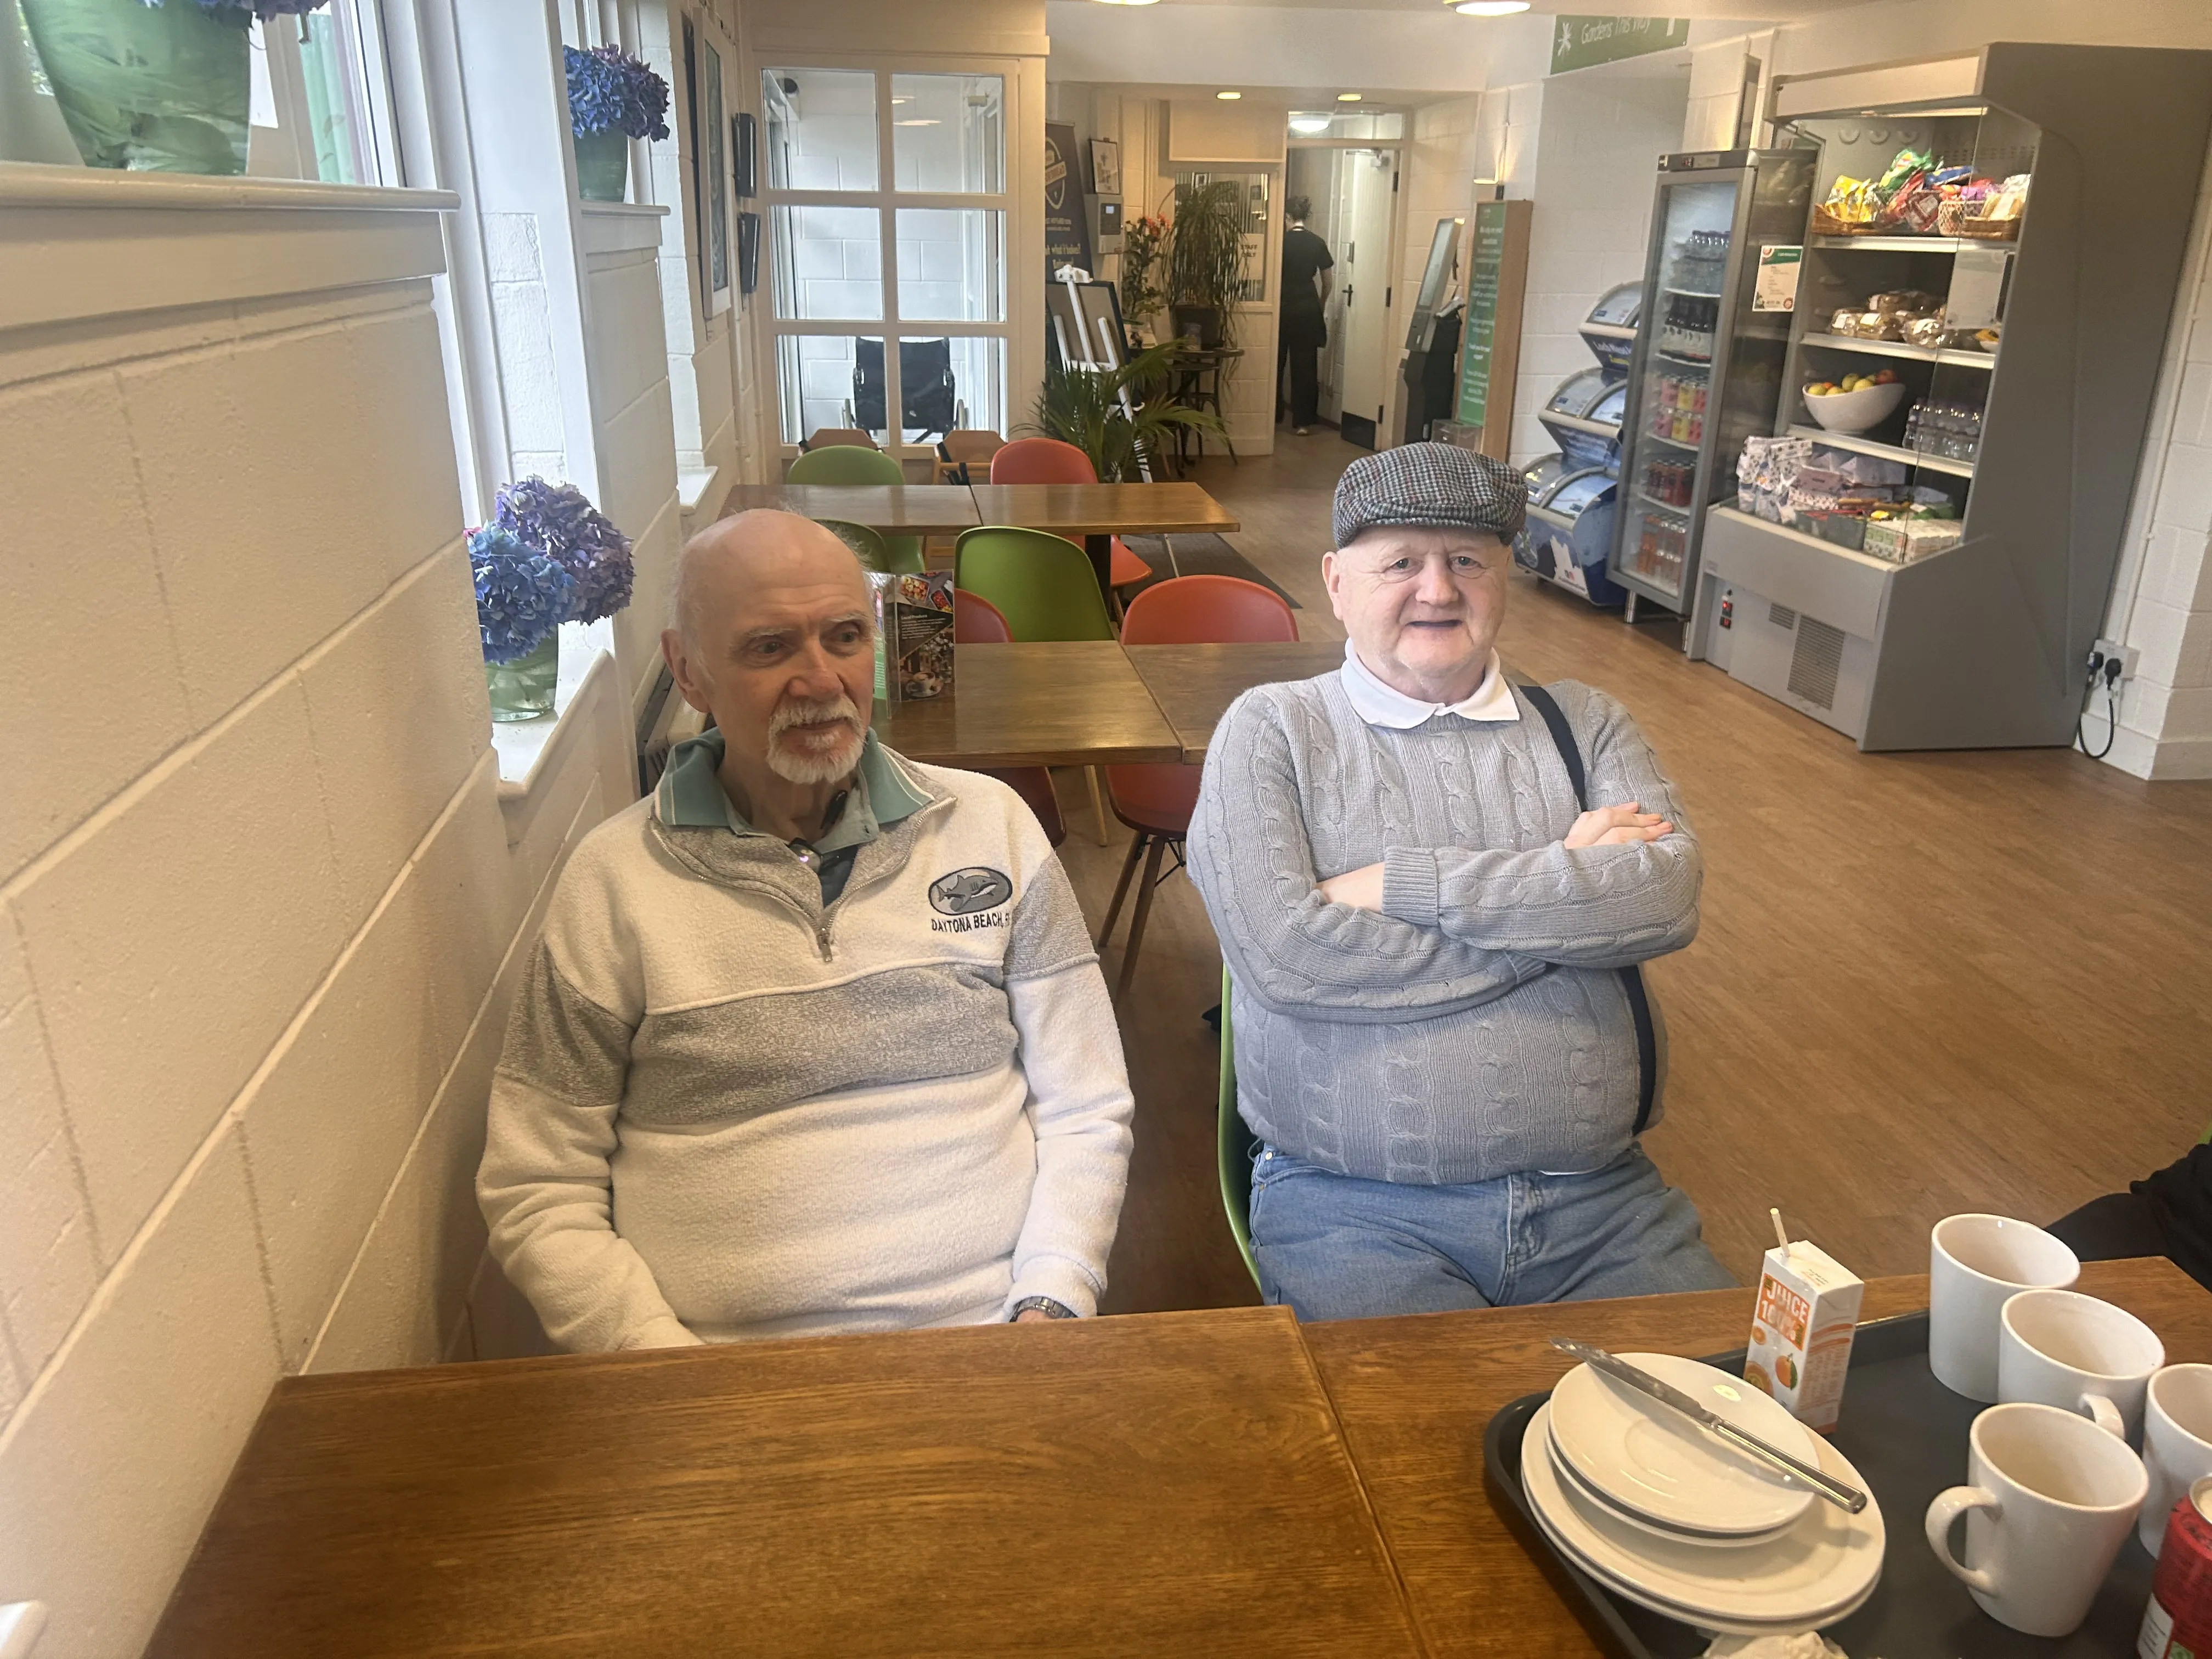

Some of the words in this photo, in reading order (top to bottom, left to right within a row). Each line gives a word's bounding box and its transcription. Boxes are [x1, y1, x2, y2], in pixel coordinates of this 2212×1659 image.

[1581, 20, 1613, 44] Gardens
[931, 916, 972, 933] DAYTONA
[1767, 1280, 1808, 1324] JUICE
